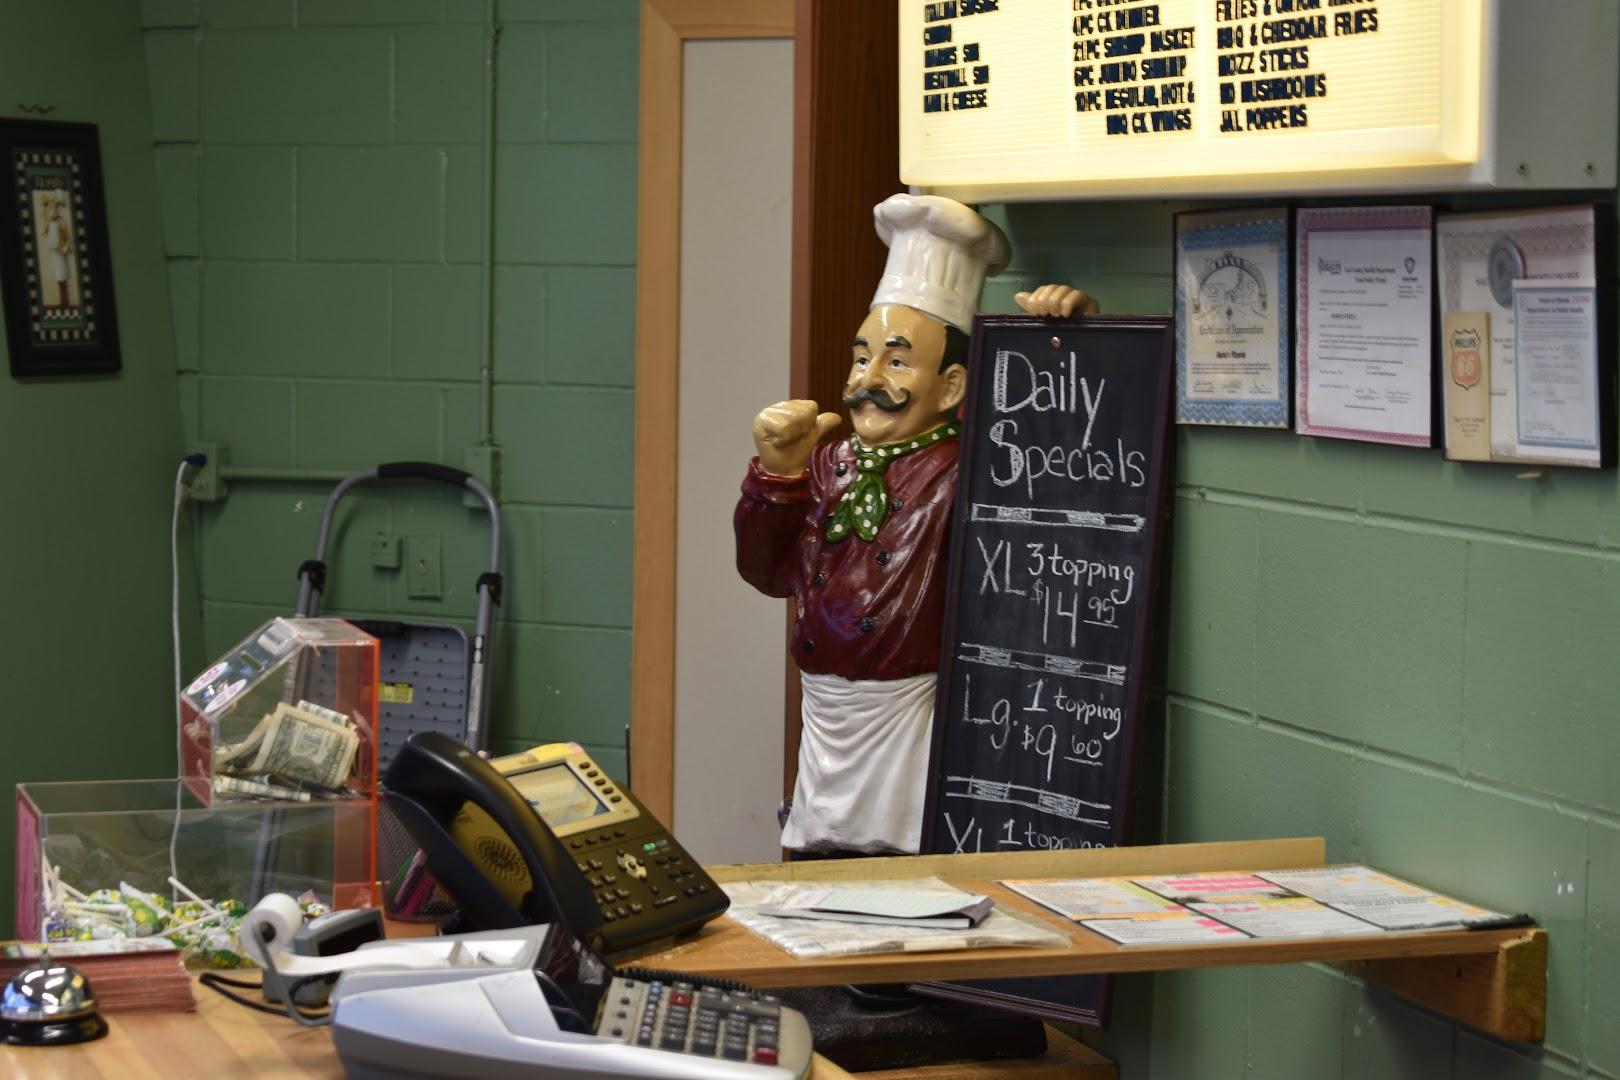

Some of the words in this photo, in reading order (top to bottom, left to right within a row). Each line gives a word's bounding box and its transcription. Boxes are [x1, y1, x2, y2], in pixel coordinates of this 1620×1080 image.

[1217, 0, 1257, 21] FRIES
[1250, 23, 1257, 46] &
[1262, 15, 1327, 45] CHEDDAR
[1335, 8, 1378, 36] FRIES
[1219, 52, 1254, 77] MOZZ
[1260, 46, 1309, 72] STICKS
[1161, 82, 1185, 105] HOT
[1241, 73, 1326, 103] MUSHROOMS
[1151, 108, 1192, 132] WINGS
[1247, 104, 1308, 131] POPPERS
[1456, 354, 1476, 382] 66
[993, 347, 1105, 450] Daily
[988, 419, 1146, 500] Specials
[976, 537, 1027, 595] XL
[1026, 543, 1044, 575] 3
[1048, 543, 1134, 604] topping
[1023, 678, 1048, 712] 1
[1054, 687, 1122, 740] topping
[1000, 818, 1023, 845] 1
